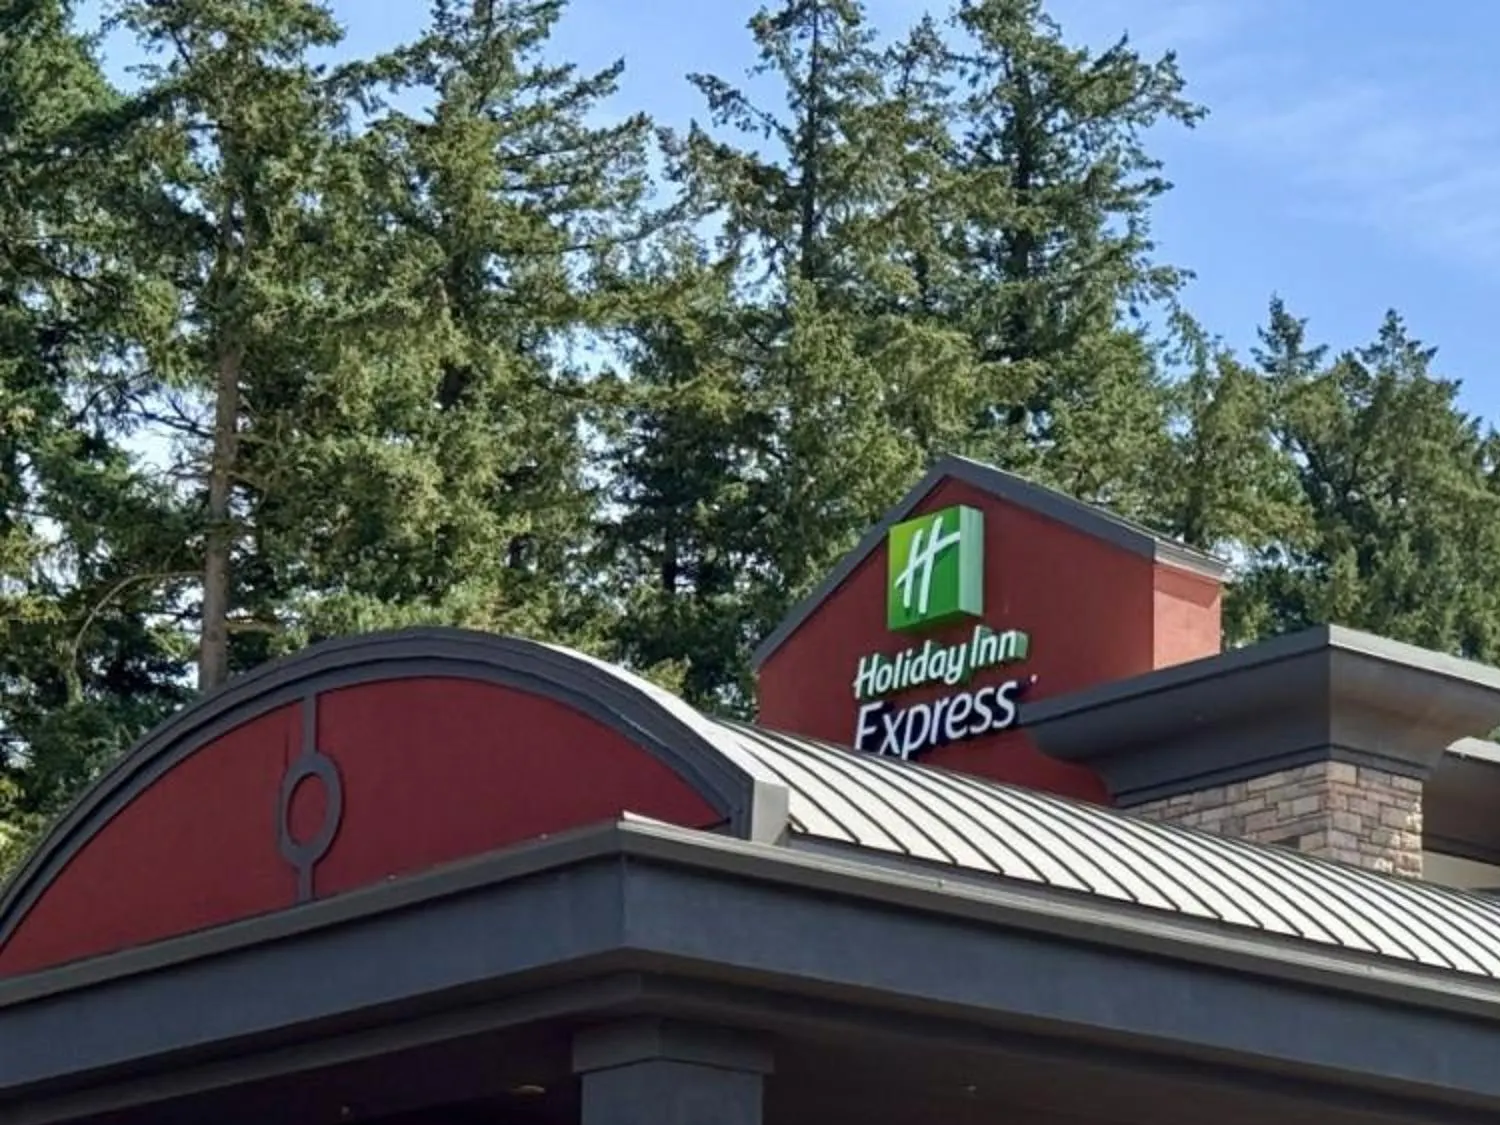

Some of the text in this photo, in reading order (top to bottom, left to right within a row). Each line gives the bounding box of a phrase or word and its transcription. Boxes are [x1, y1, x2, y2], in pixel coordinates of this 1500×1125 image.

[894, 516, 961, 614] H
[854, 624, 1019, 698] Holiday Inn
[854, 680, 1017, 760] Express
